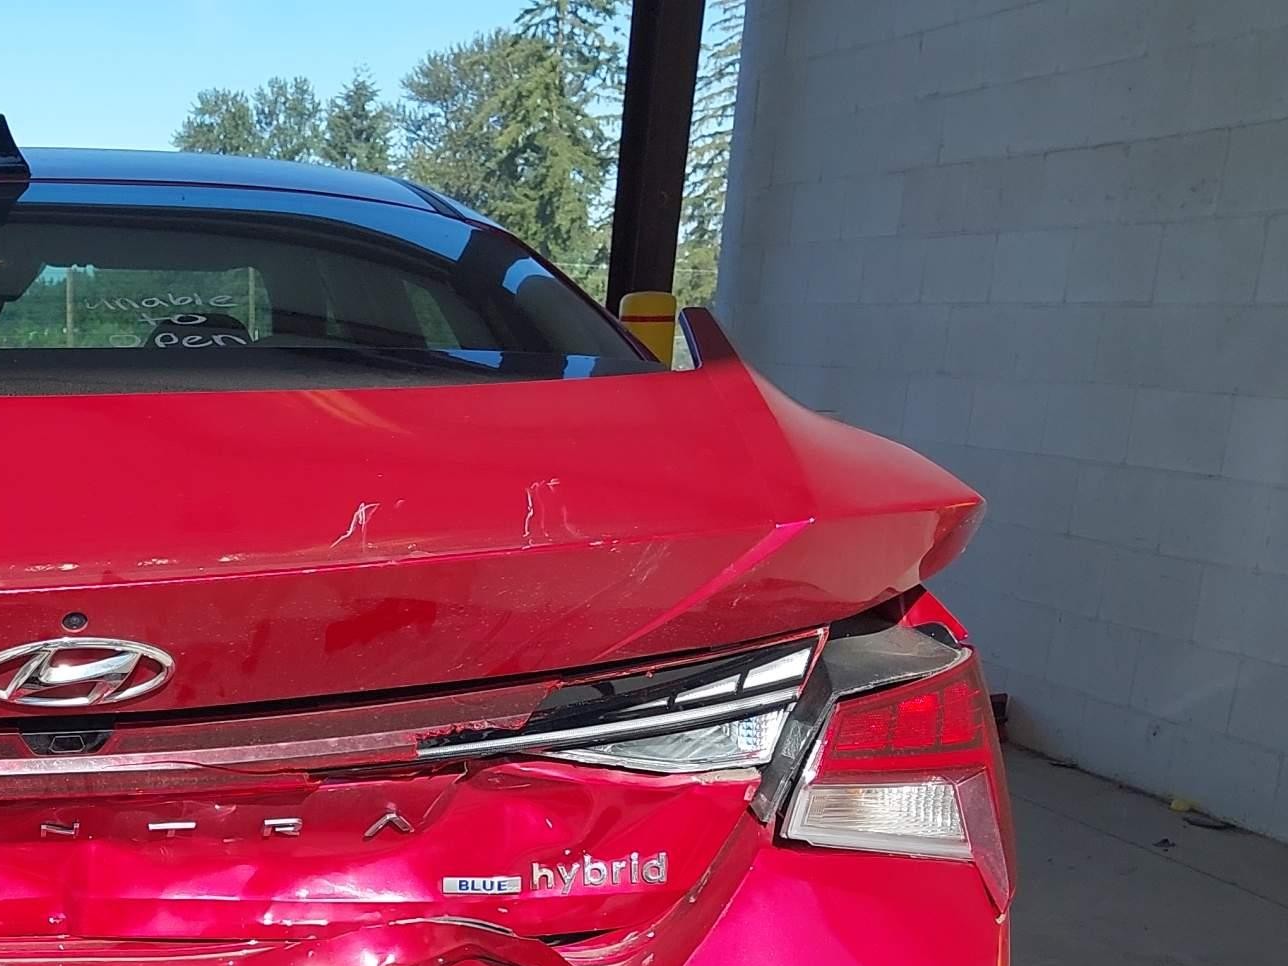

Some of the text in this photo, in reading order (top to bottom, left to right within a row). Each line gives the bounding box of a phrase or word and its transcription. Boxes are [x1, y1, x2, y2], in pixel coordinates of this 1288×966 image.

[138, 313, 208, 326] to
[458, 851, 667, 895] BLUE hybrid
